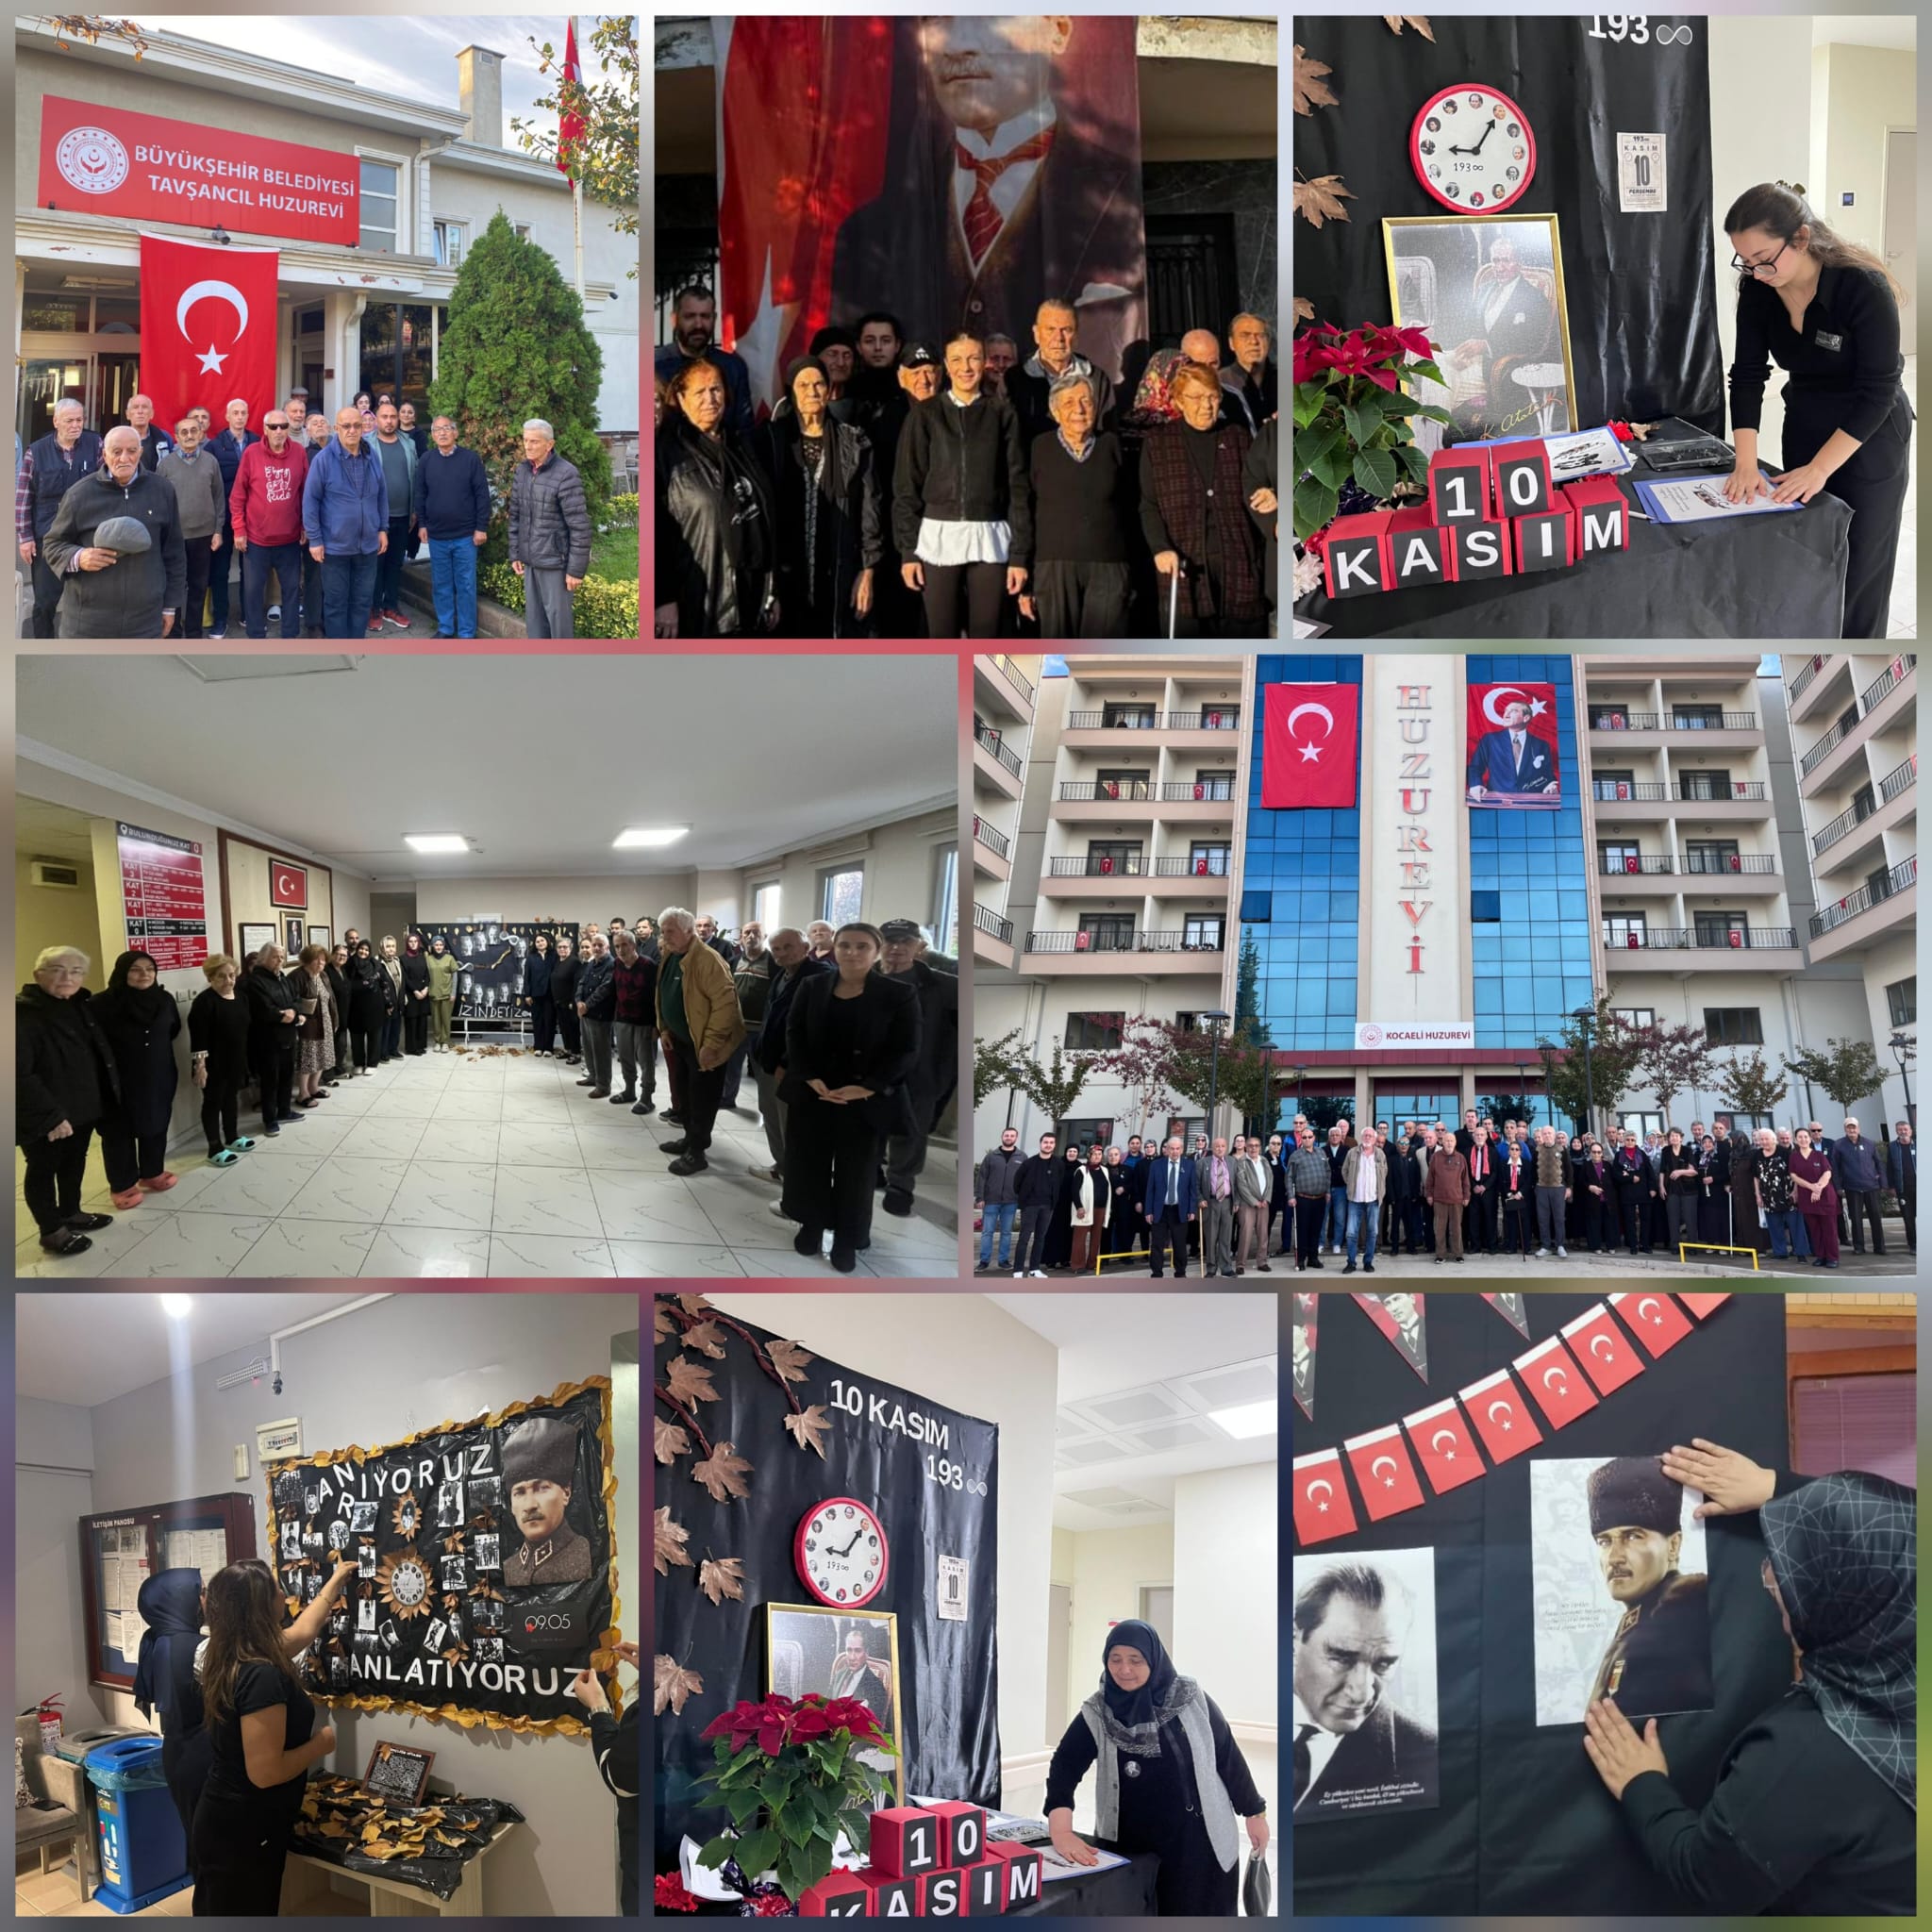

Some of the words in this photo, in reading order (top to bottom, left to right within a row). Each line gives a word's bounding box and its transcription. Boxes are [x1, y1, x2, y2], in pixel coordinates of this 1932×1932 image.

[135, 144, 259, 181] BÜYÜKŞEHİR
[263, 168, 355, 197] BELEDİYESİ
[1635, 155, 1651, 187] 10
[148, 175, 255, 206] TAVŞANCIL
[258, 192, 344, 219] HUZUREVİ
[1445, 466, 1539, 517] 10
[1336, 510, 1623, 590] KASIM
[1396, 685, 1433, 974] HUZUREVİ
[1386, 1030, 1424, 1041] KOCAELİ
[1425, 1029, 1471, 1041] HUZUREVİ
[830, 1379, 863, 1416] 10
[869, 1393, 949, 1451] KASIM
[948, 1574, 958, 1600] 10
[350, 1653, 587, 1698] ANLATIYORUZ
[909, 1819, 977, 1867] 10
